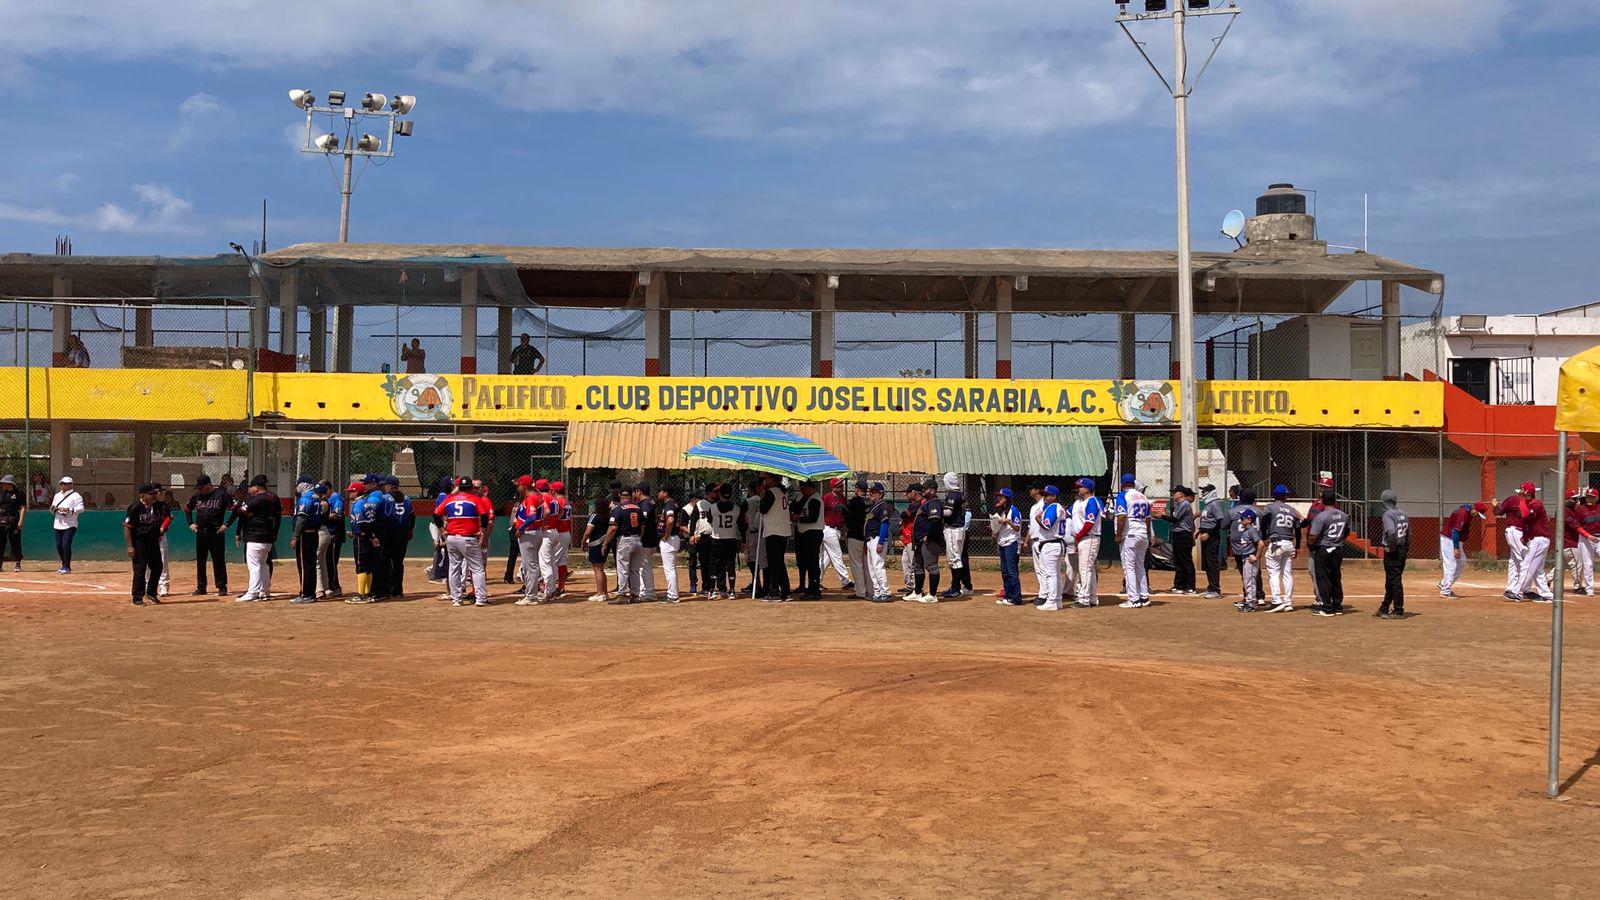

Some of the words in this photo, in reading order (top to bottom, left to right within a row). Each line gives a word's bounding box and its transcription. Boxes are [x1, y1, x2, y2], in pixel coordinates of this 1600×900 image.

[462, 376, 566, 418] PACIFICO
[585, 385, 650, 410] CLUB
[658, 385, 798, 411] DEPORTIVO
[806, 386, 865, 411] JOSE
[873, 386, 927, 412] LUIS
[936, 387, 1053, 416] SARABIA,
[395, 503, 405, 515] 5
[454, 500, 464, 516] 5
[1133, 503, 1149, 519] 23
[718, 514, 734, 529] 12
[1276, 513, 1294, 528] 26
[1327, 521, 1346, 538] 27
